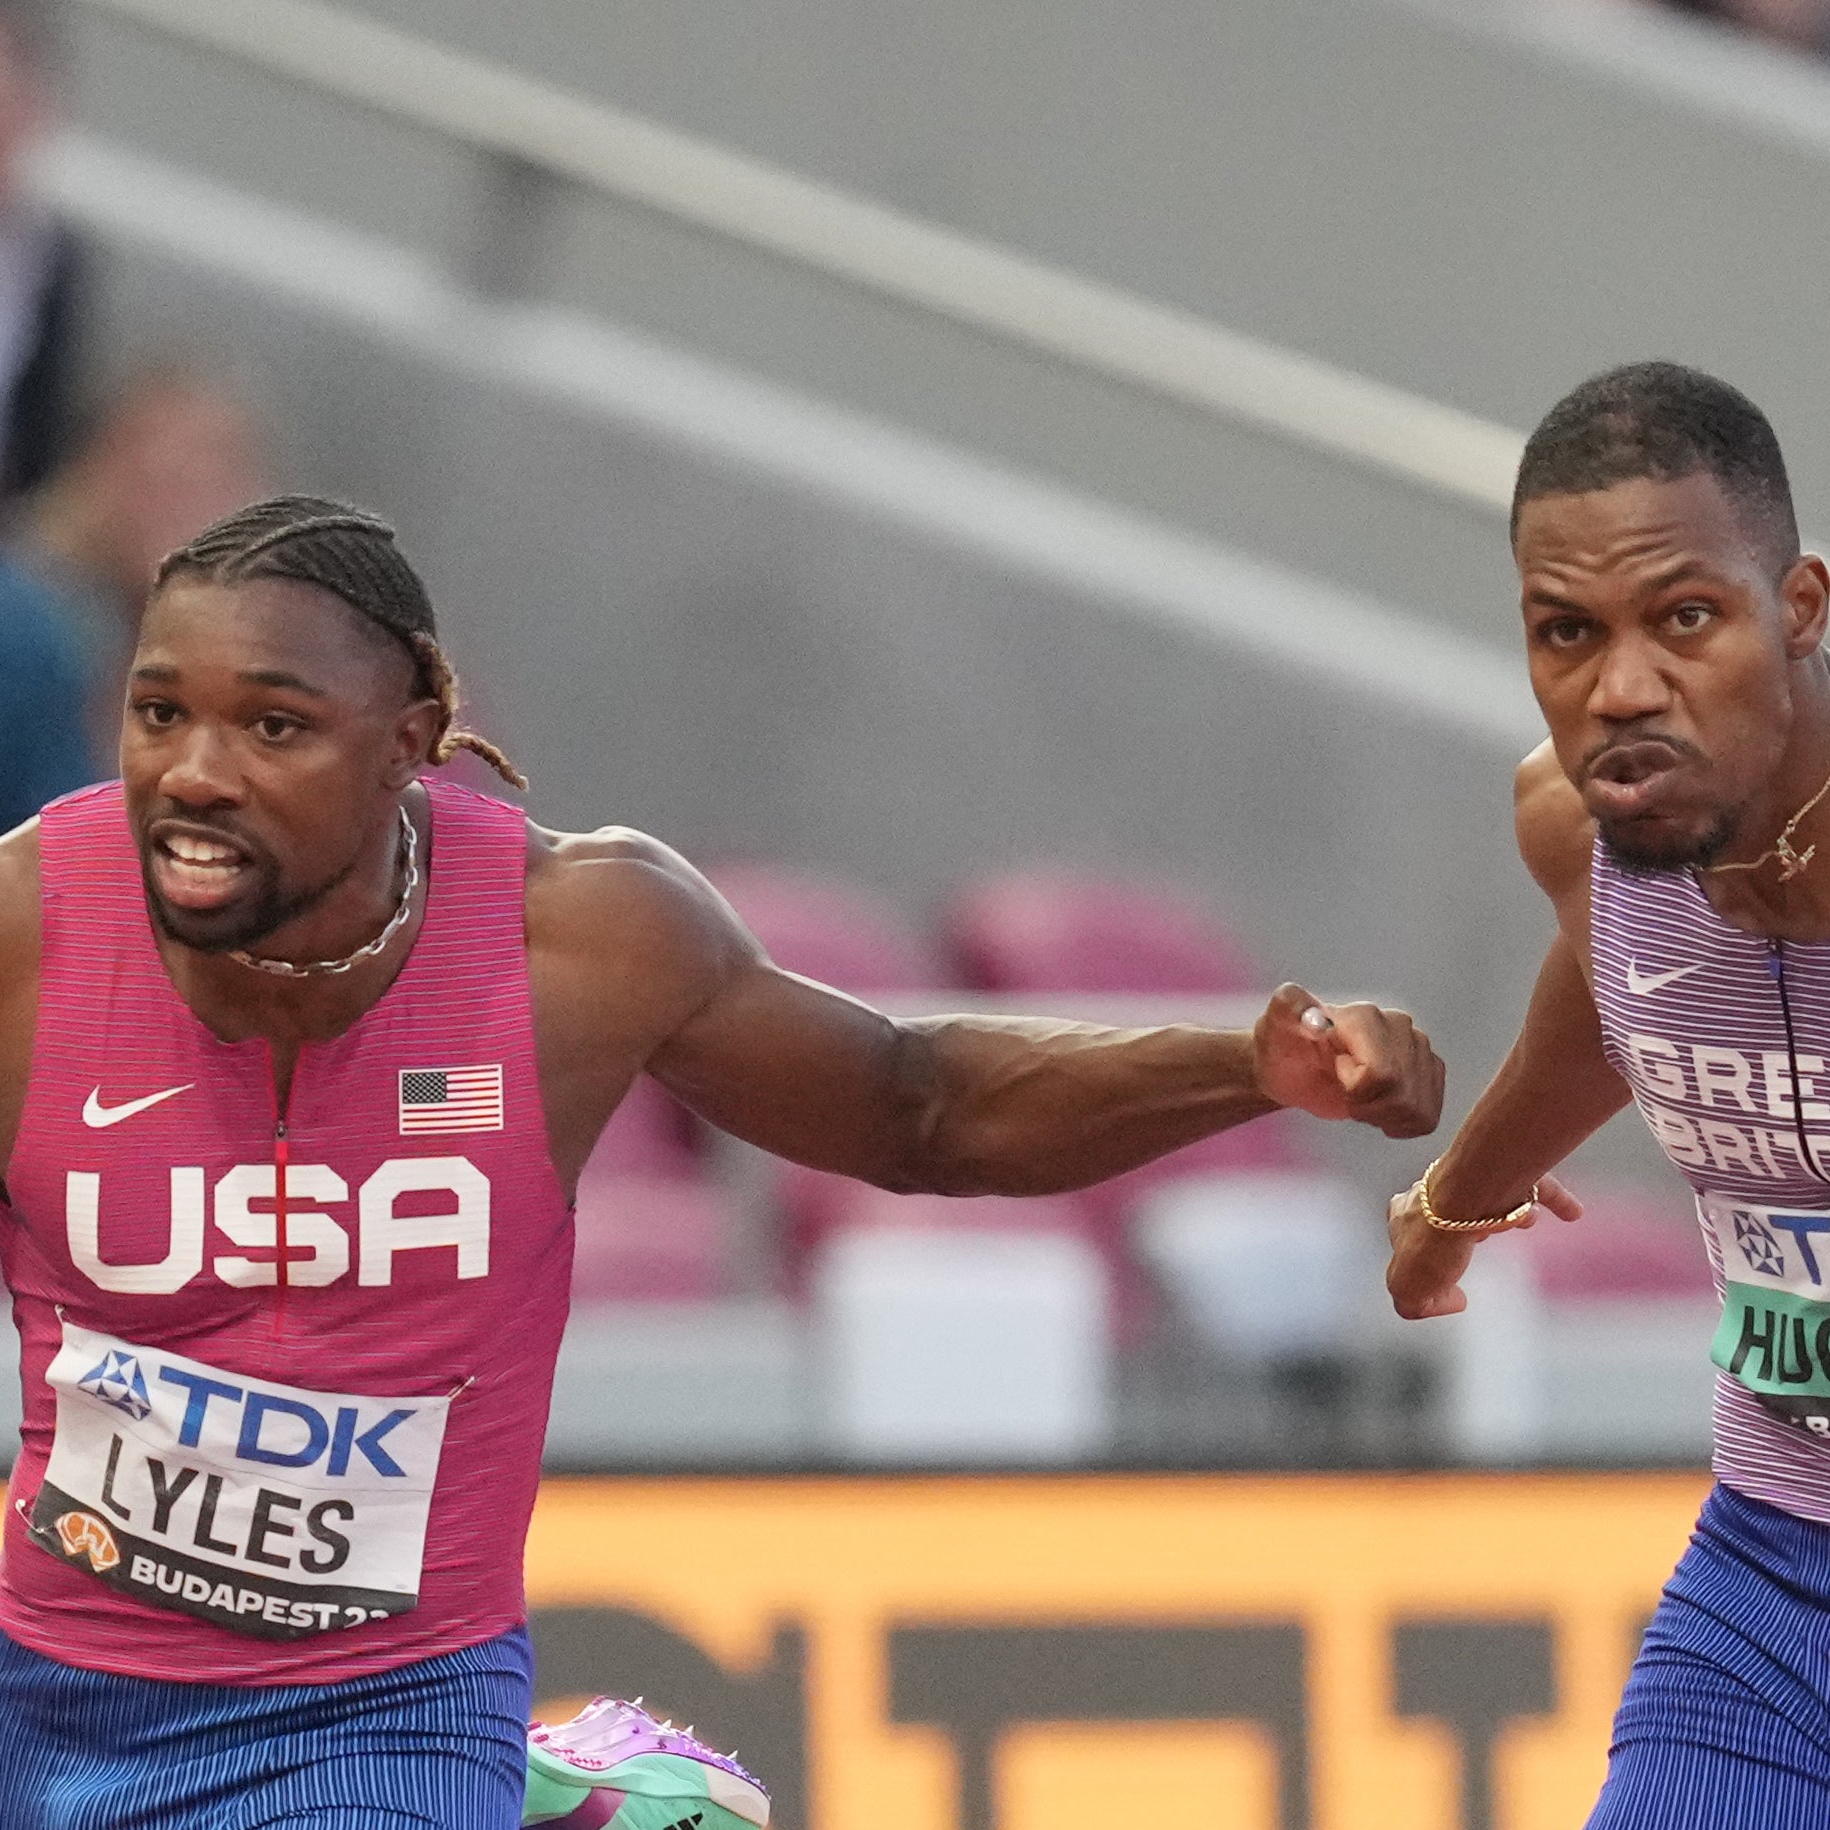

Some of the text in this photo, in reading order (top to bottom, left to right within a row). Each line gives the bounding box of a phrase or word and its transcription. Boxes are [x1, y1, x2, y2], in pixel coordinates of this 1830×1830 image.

[66, 1156, 490, 1294] USA
[157, 1365, 419, 1477] TDK
[101, 1433, 355, 1575] LYLES
[129, 1555, 340, 1631] BUDAPEST
